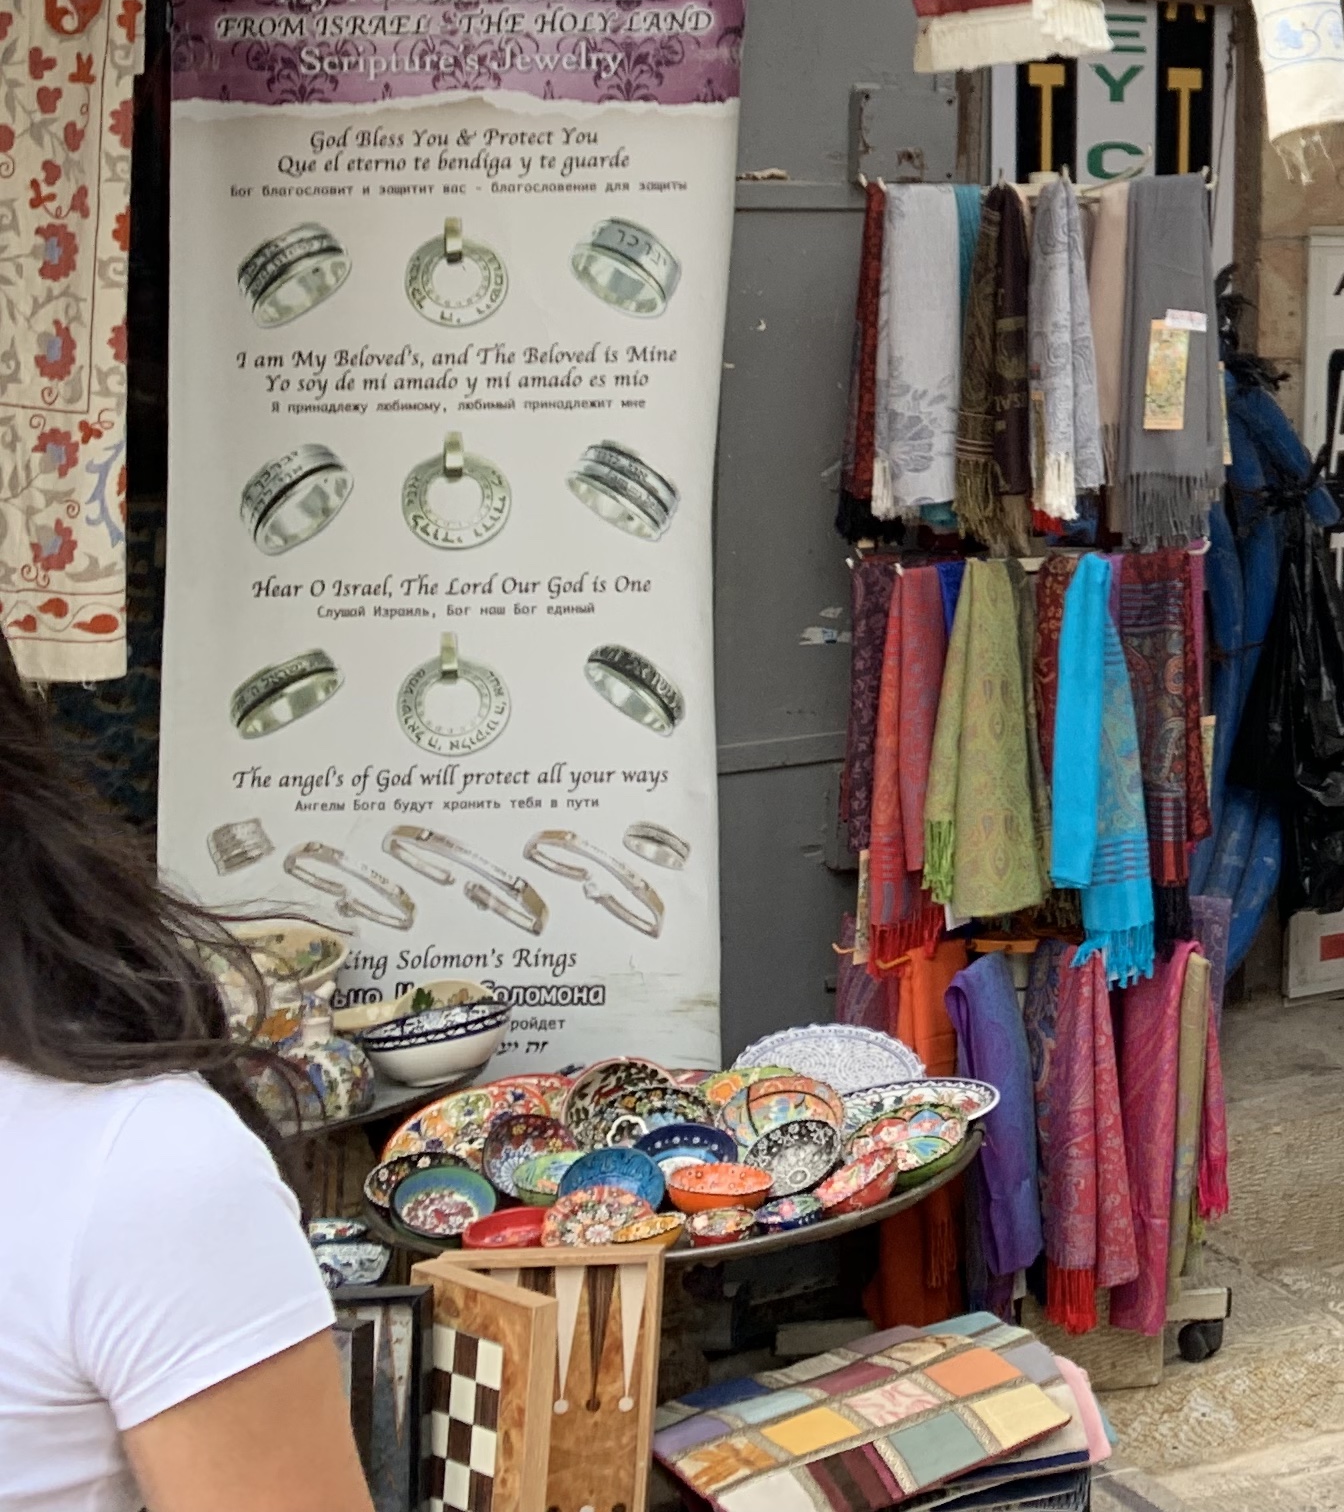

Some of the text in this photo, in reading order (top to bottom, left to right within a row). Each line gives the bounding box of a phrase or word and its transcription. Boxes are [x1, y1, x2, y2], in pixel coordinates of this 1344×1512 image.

[217, 6, 713, 38] FROM ISRAEL THE HOLY LAND
[300, 43, 624, 80] Scripture's Jewelry
[310, 126, 598, 154] God Bless You & Protect You
[278, 147, 630, 178] Que el eterno te bendiga y te guarde
[236, 342, 677, 376] I am My Beloved's, and The Beloved is Mine
[265, 374, 291, 392] Yo
[297, 379, 328, 400] soy
[335, 369, 355, 391] de
[394, 368, 458, 390] amado
[464, 375, 478, 399] y
[518, 366, 583, 388] amado
[589, 375, 606, 387] es
[252, 571, 652, 599] Hear O Israel, The Lord Our God is One
[232, 762, 669, 796] The angel's of God will protect all your ways
[393, 798, 434, 814] будут
[510, 796, 542, 809] тебя
[566, 798, 600, 811] пути
[396, 944, 577, 978] Solomon's Rings
[508, 1017, 567, 1033] ройдет
